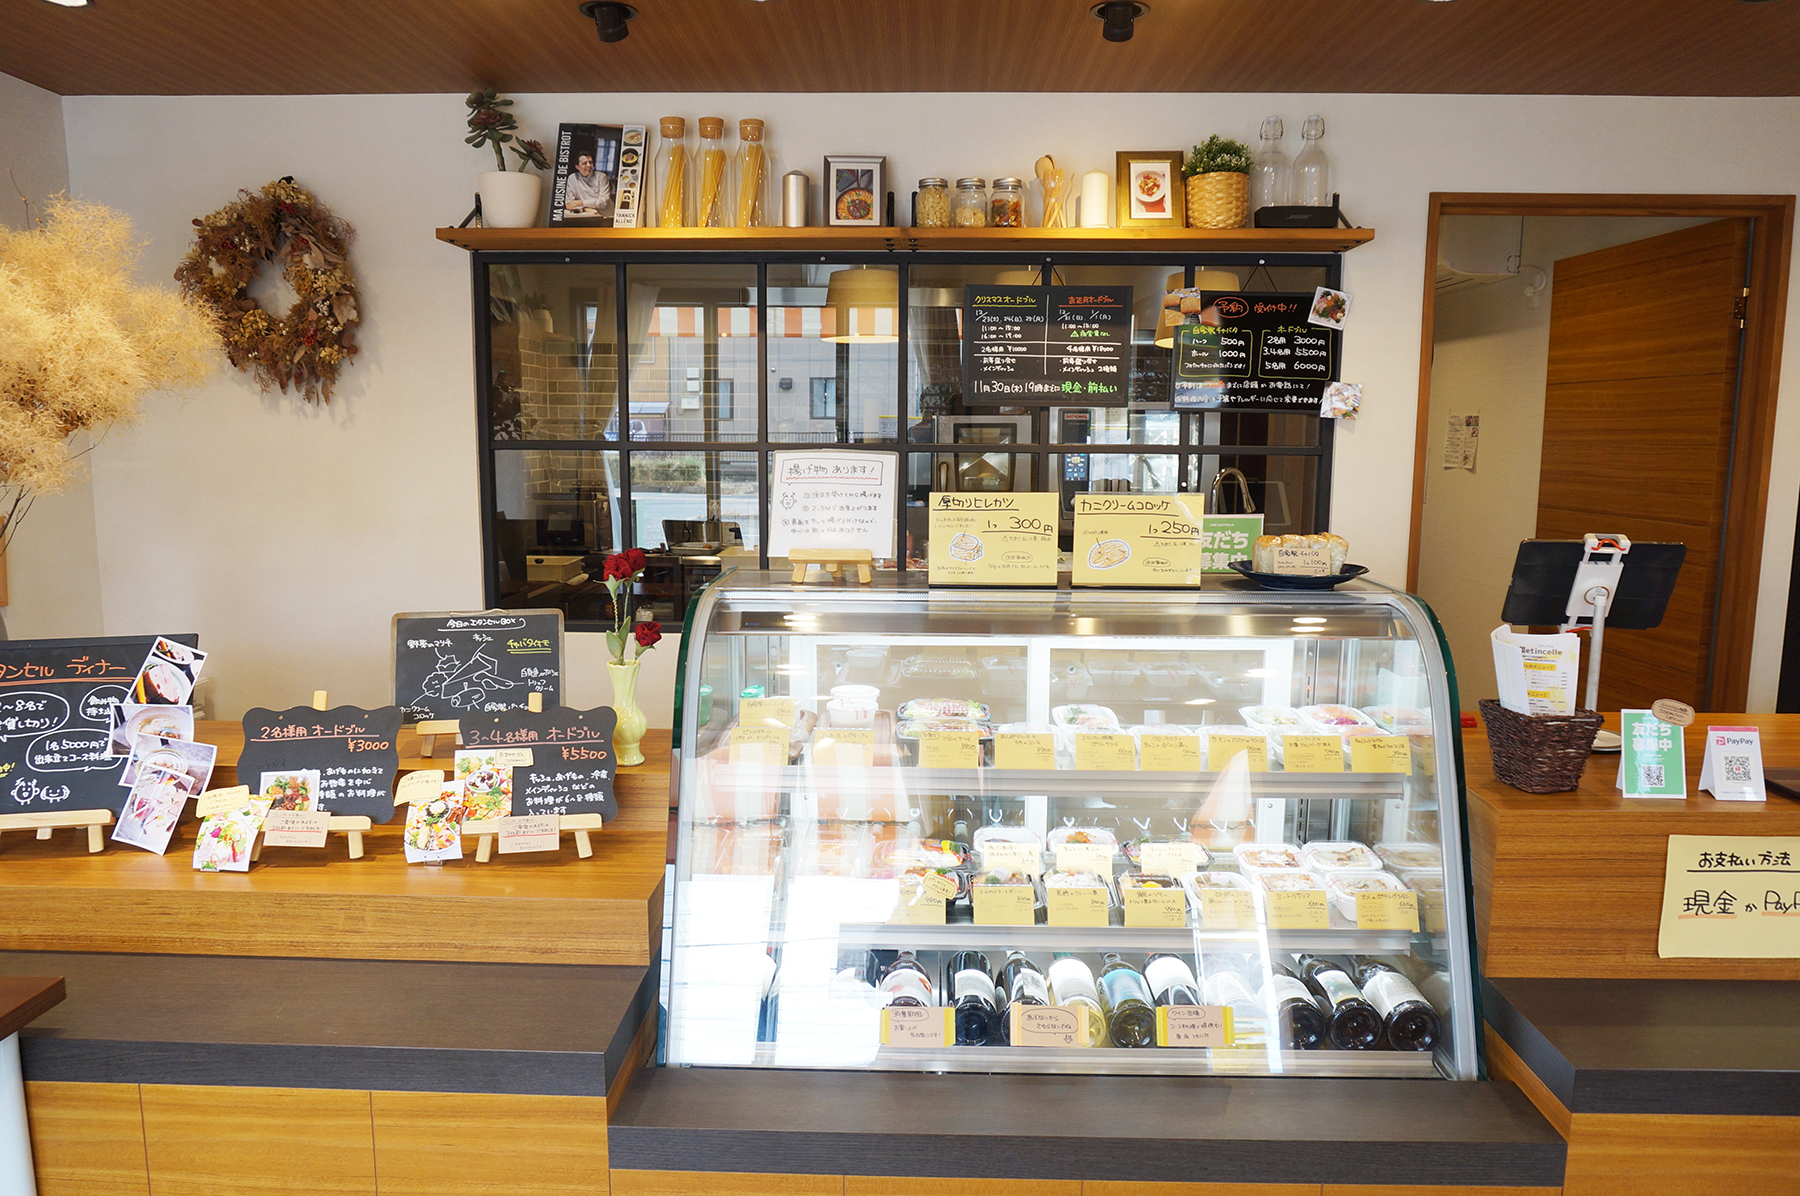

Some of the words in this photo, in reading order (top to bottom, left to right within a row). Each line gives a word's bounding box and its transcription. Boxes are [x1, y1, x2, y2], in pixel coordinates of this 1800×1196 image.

[559, 130, 572, 163] BISTROT
[557, 164, 568, 175] DE
[554, 176, 567, 207] CUISINE
[552, 210, 564, 222] MA
[1217, 301, 1244, 313] 予約
[1220, 336, 1246, 347] 500円
[1293, 335, 1326, 346] 3000円
[1218, 349, 1247, 358] 1000円
[1294, 347, 1327, 357] 5500円
[1293, 360, 1326, 372] 6000円
[787, 463, 828, 476] 揚げ物
[938, 495, 1015, 510] 厚切りヒレカツ
[1081, 499, 1171, 512] カニクリームコロッケ
[1009, 516, 1053, 533] 300円
[1160, 520, 1199, 535] 250円
[66, 655, 127, 675] ディナー
[260, 725, 308, 739] 2名様用
[311, 723, 366, 737] オードブル
[545, 726, 600, 741] オードブル
[347, 737, 390, 753] ¥3000
[1726, 736, 1754, 746] PayPay
[561, 746, 608, 761] ¥5500
[1683, 889, 1738, 916] 現金
